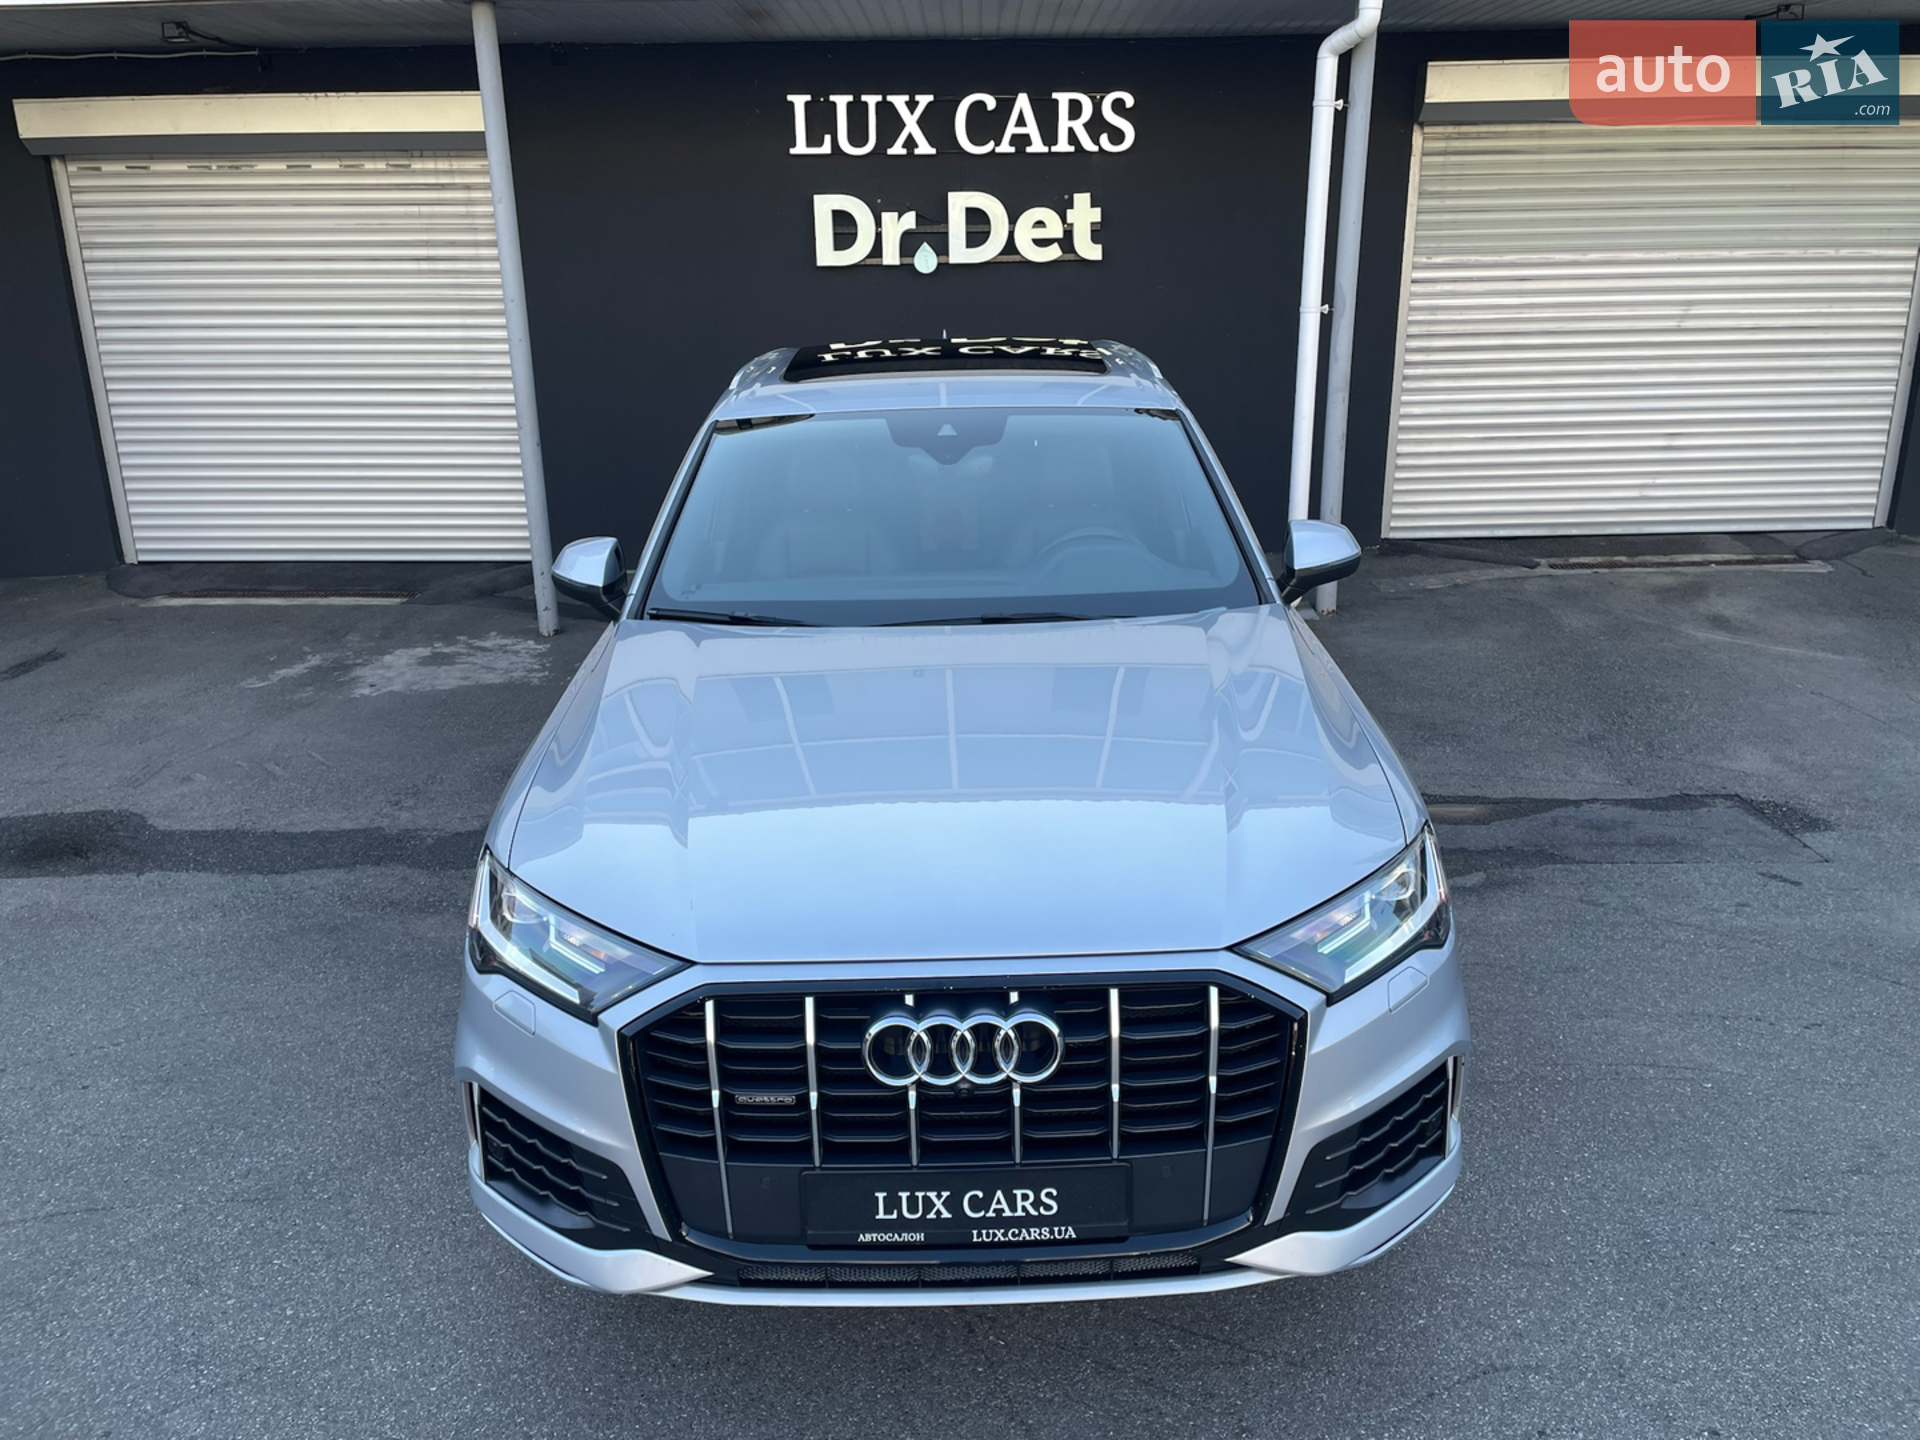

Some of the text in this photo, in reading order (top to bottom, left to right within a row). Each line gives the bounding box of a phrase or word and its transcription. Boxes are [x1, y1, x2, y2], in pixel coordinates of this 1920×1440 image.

[786, 90, 1136, 157] LUX CARS
[874, 1187, 1059, 1220] LUX CARS
[857, 1232, 925, 1243] АВТОСАЛОН
[971, 1226, 1077, 1243] LUX.CARS.UA
